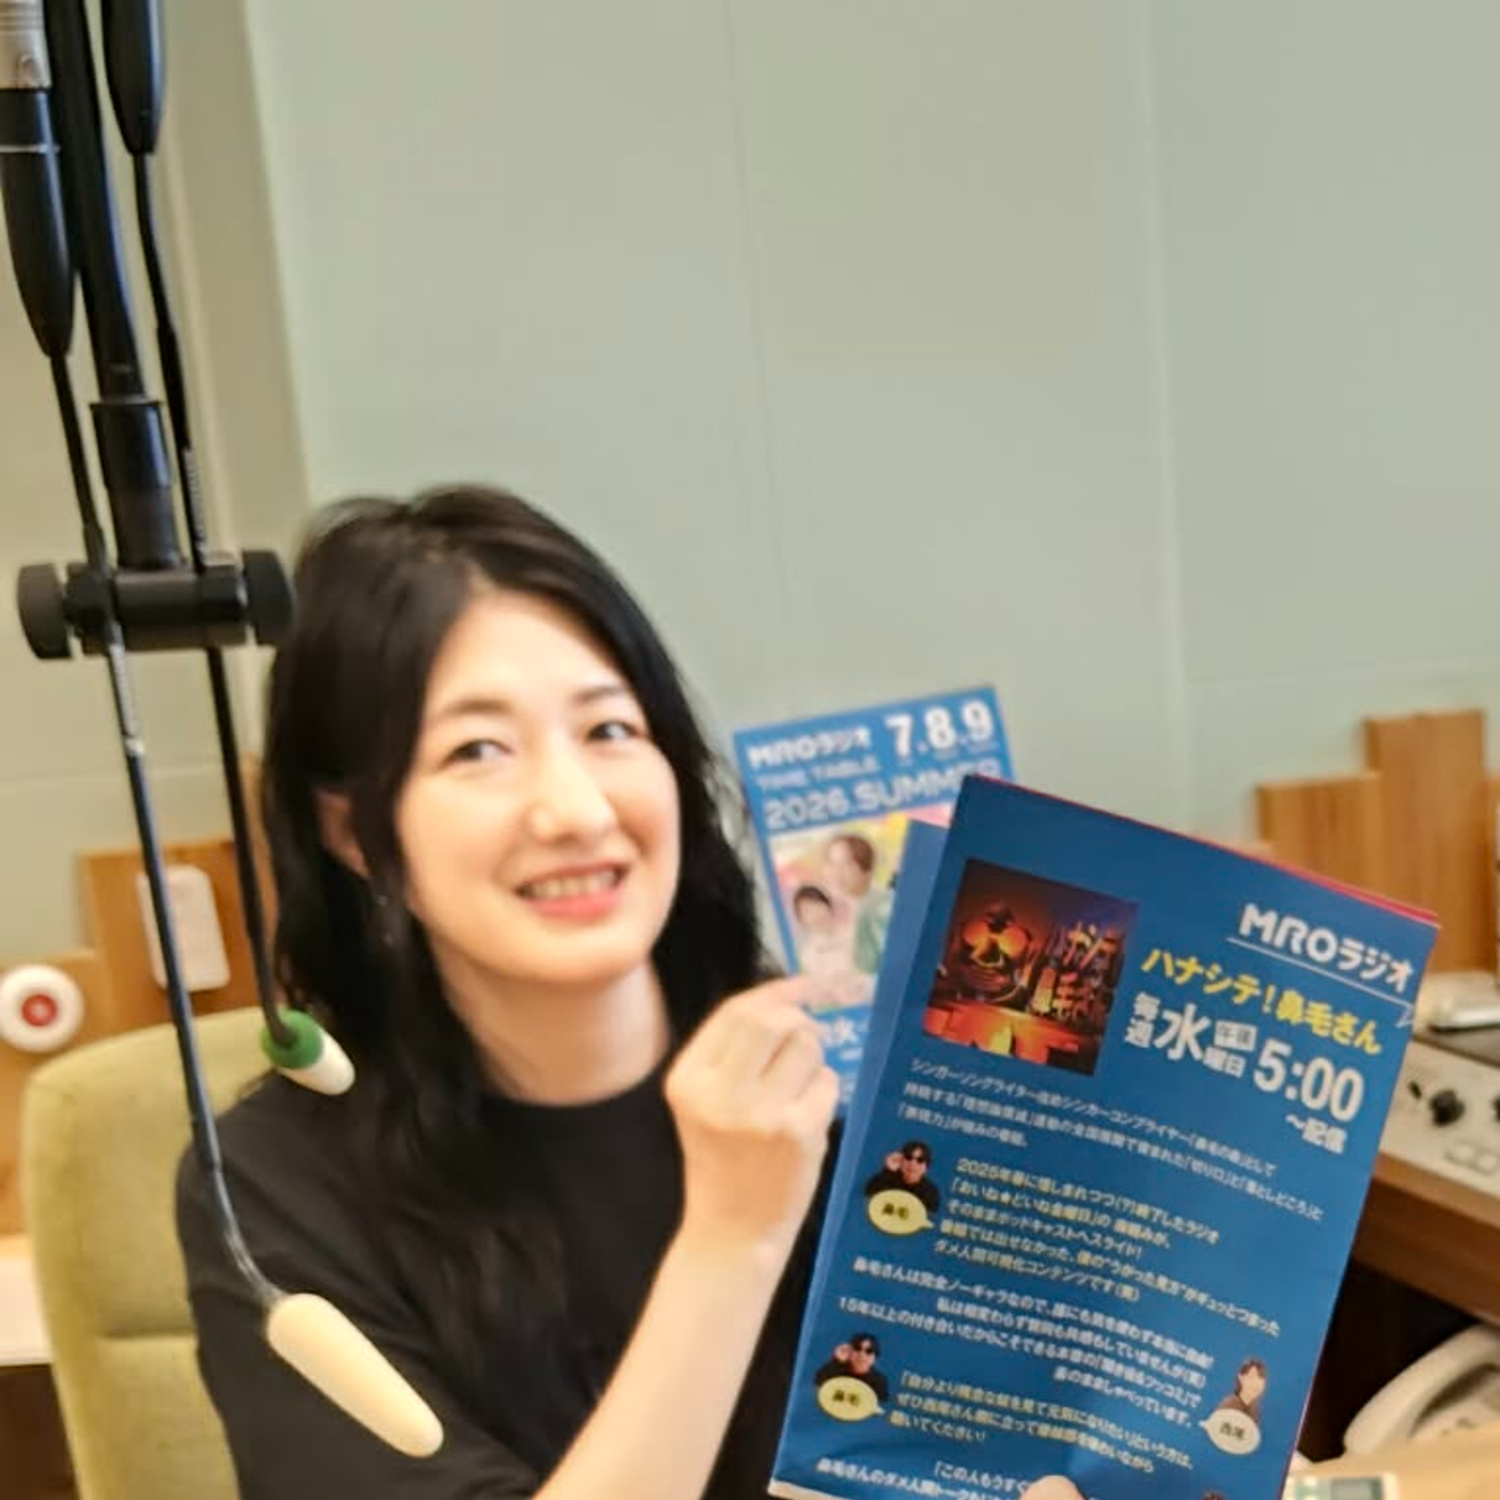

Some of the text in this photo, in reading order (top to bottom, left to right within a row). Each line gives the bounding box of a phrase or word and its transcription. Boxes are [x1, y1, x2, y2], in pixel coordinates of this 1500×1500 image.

[884, 699, 995, 758] 7.8.9
[1239, 904, 1414, 993] MROラジオ
[1253, 1038, 1364, 1122] 5:00
